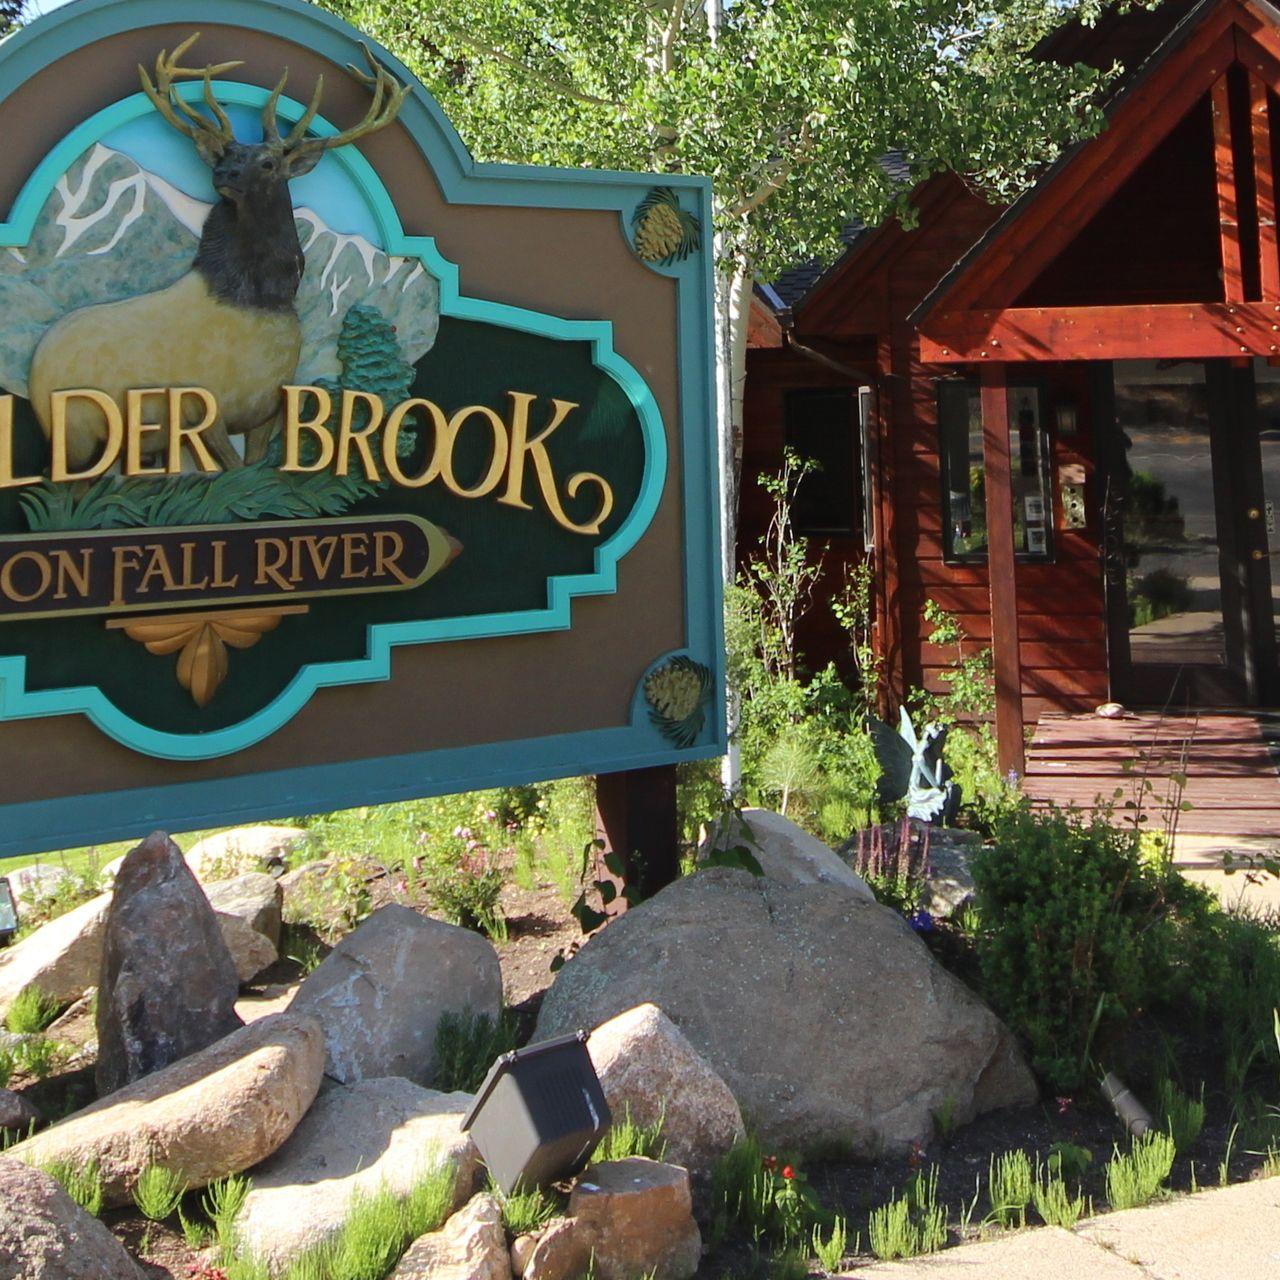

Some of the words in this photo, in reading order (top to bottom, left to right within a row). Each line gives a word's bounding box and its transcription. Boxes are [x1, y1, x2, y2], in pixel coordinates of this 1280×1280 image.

[279, 385, 614, 536] BROOK
[0, 548, 93, 603] ON
[109, 540, 239, 607] FALL
[254, 530, 418, 592] RIVER
